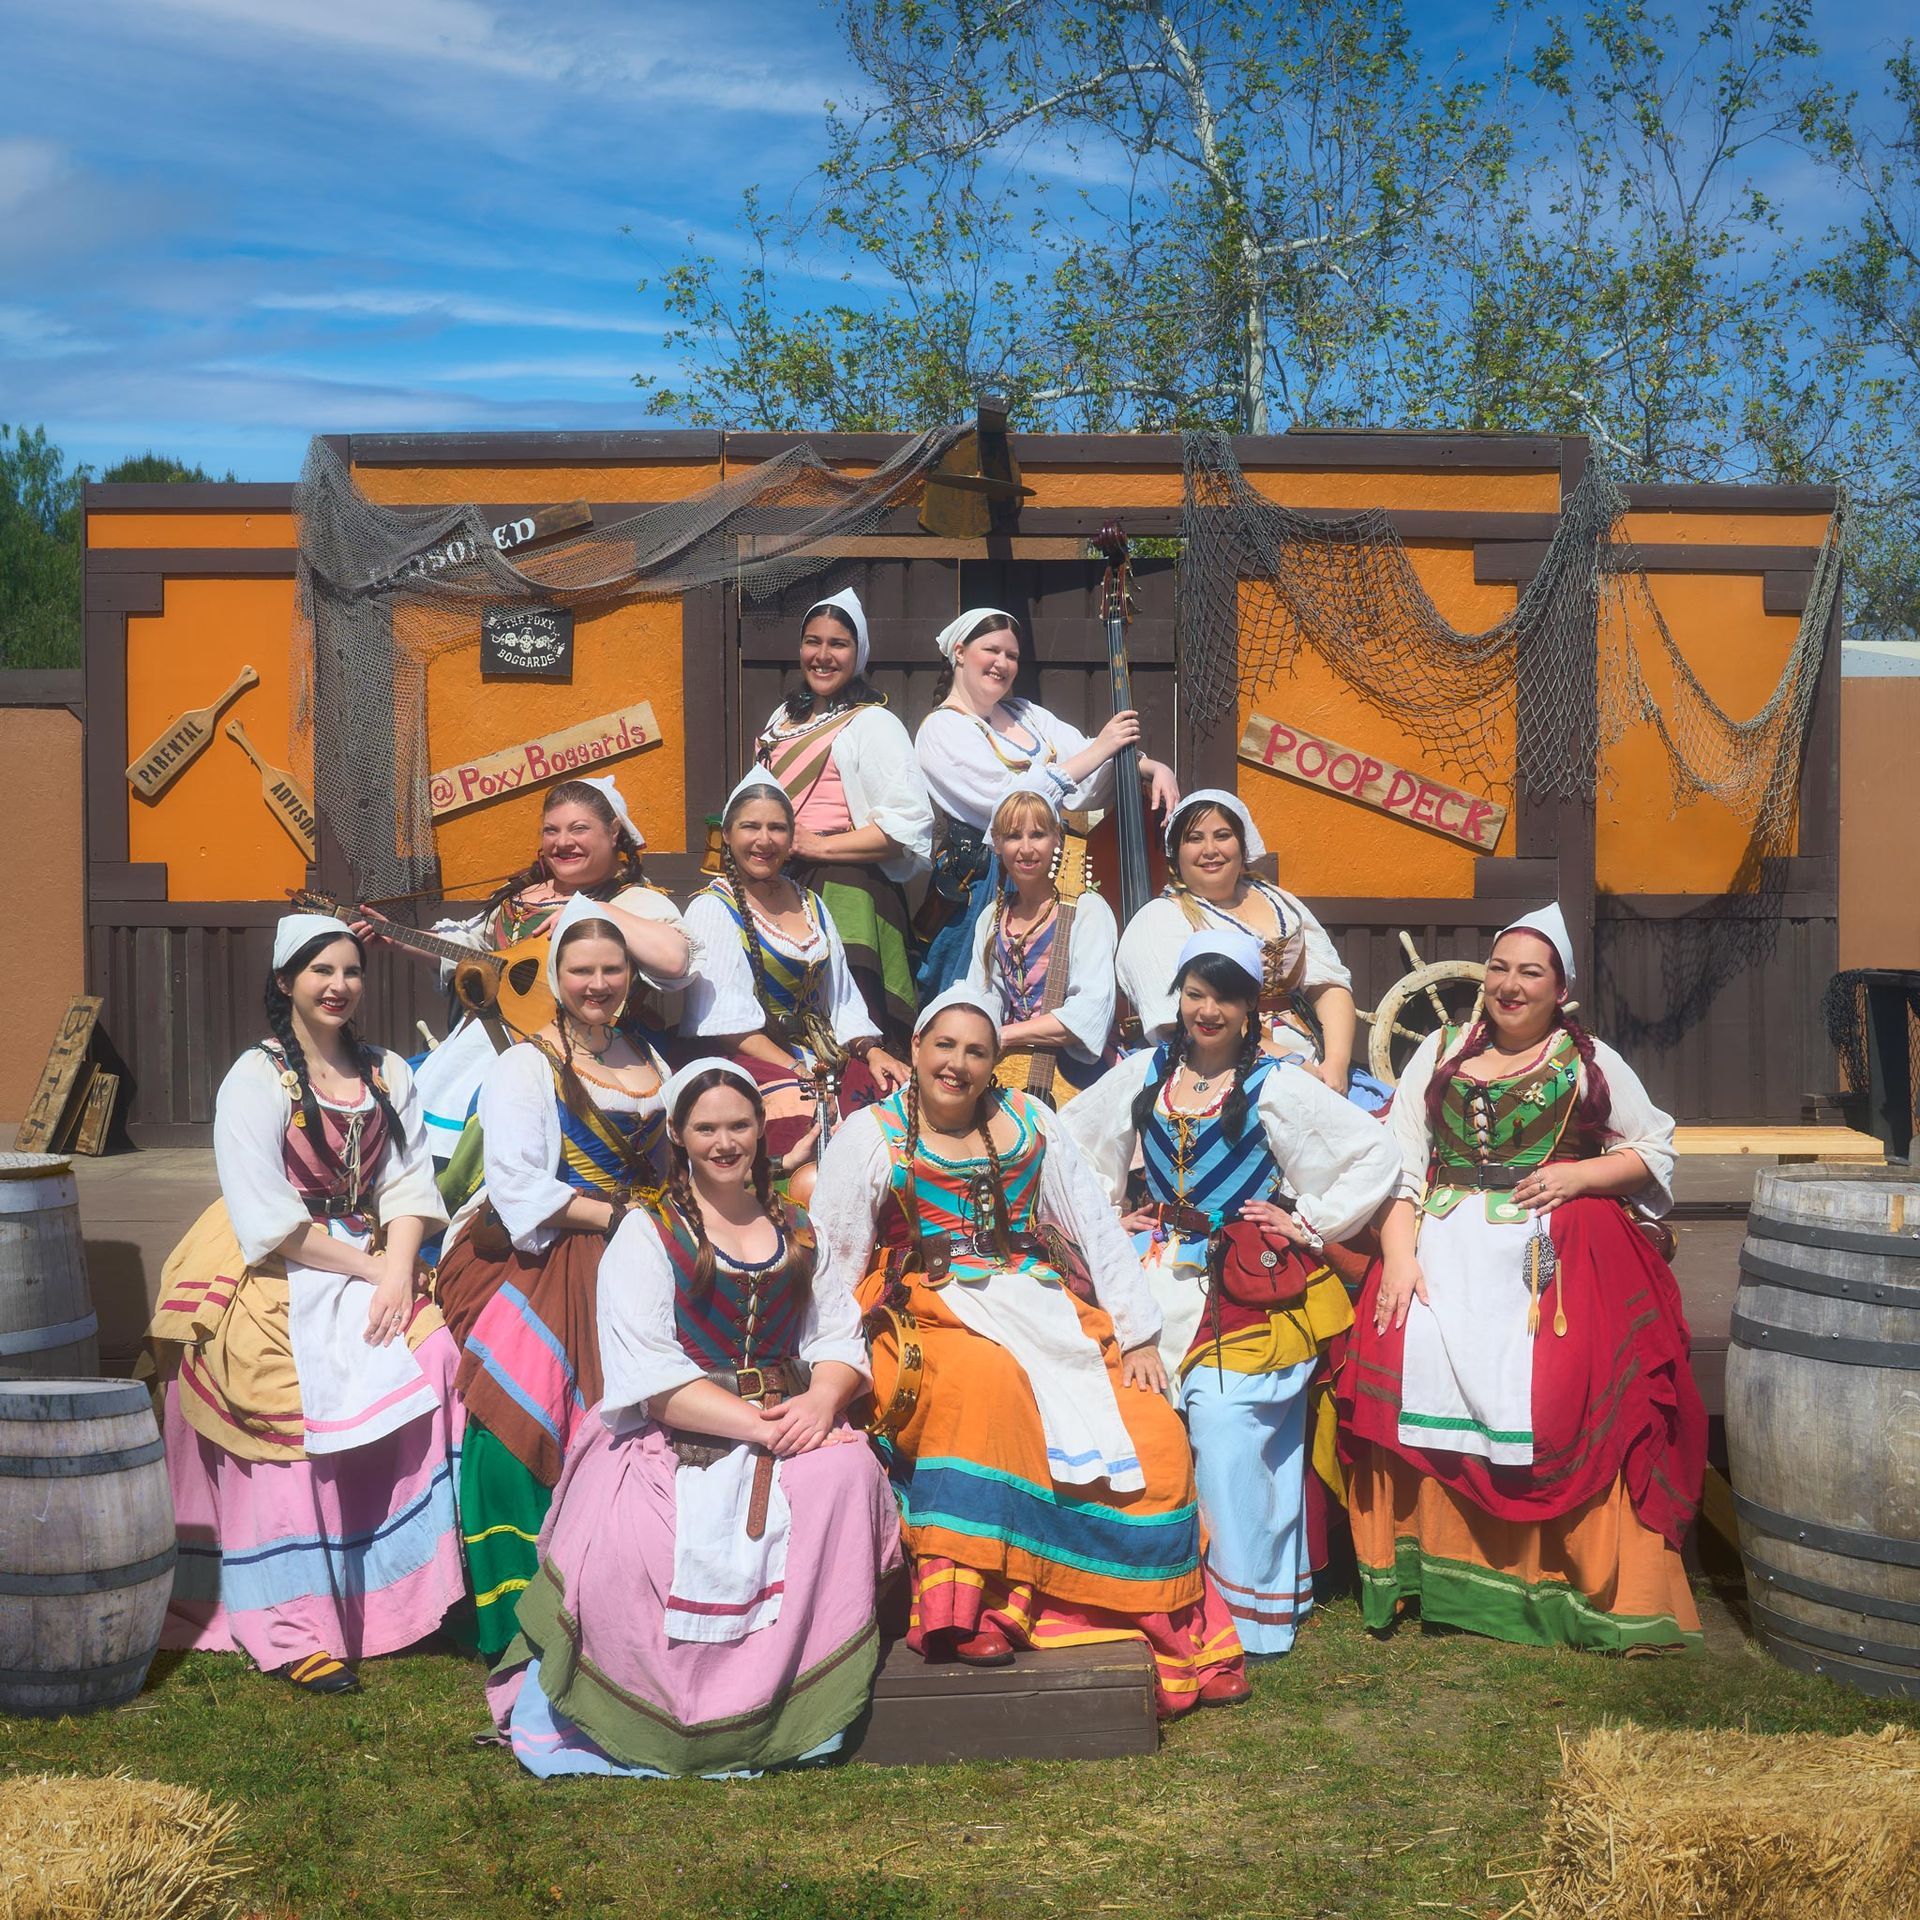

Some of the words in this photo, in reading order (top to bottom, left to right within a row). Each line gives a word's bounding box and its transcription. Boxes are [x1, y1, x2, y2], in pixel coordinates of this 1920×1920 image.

[503, 615, 525, 629] THE
[527, 614, 555, 630] POXY
[497, 648, 556, 668] BOGGARDS
[138, 720, 204, 785] PARENTAL
[1262, 723, 1384, 799] POOP
[1382, 769, 1493, 842] DECK
[270, 781, 317, 846] ADVISOR
